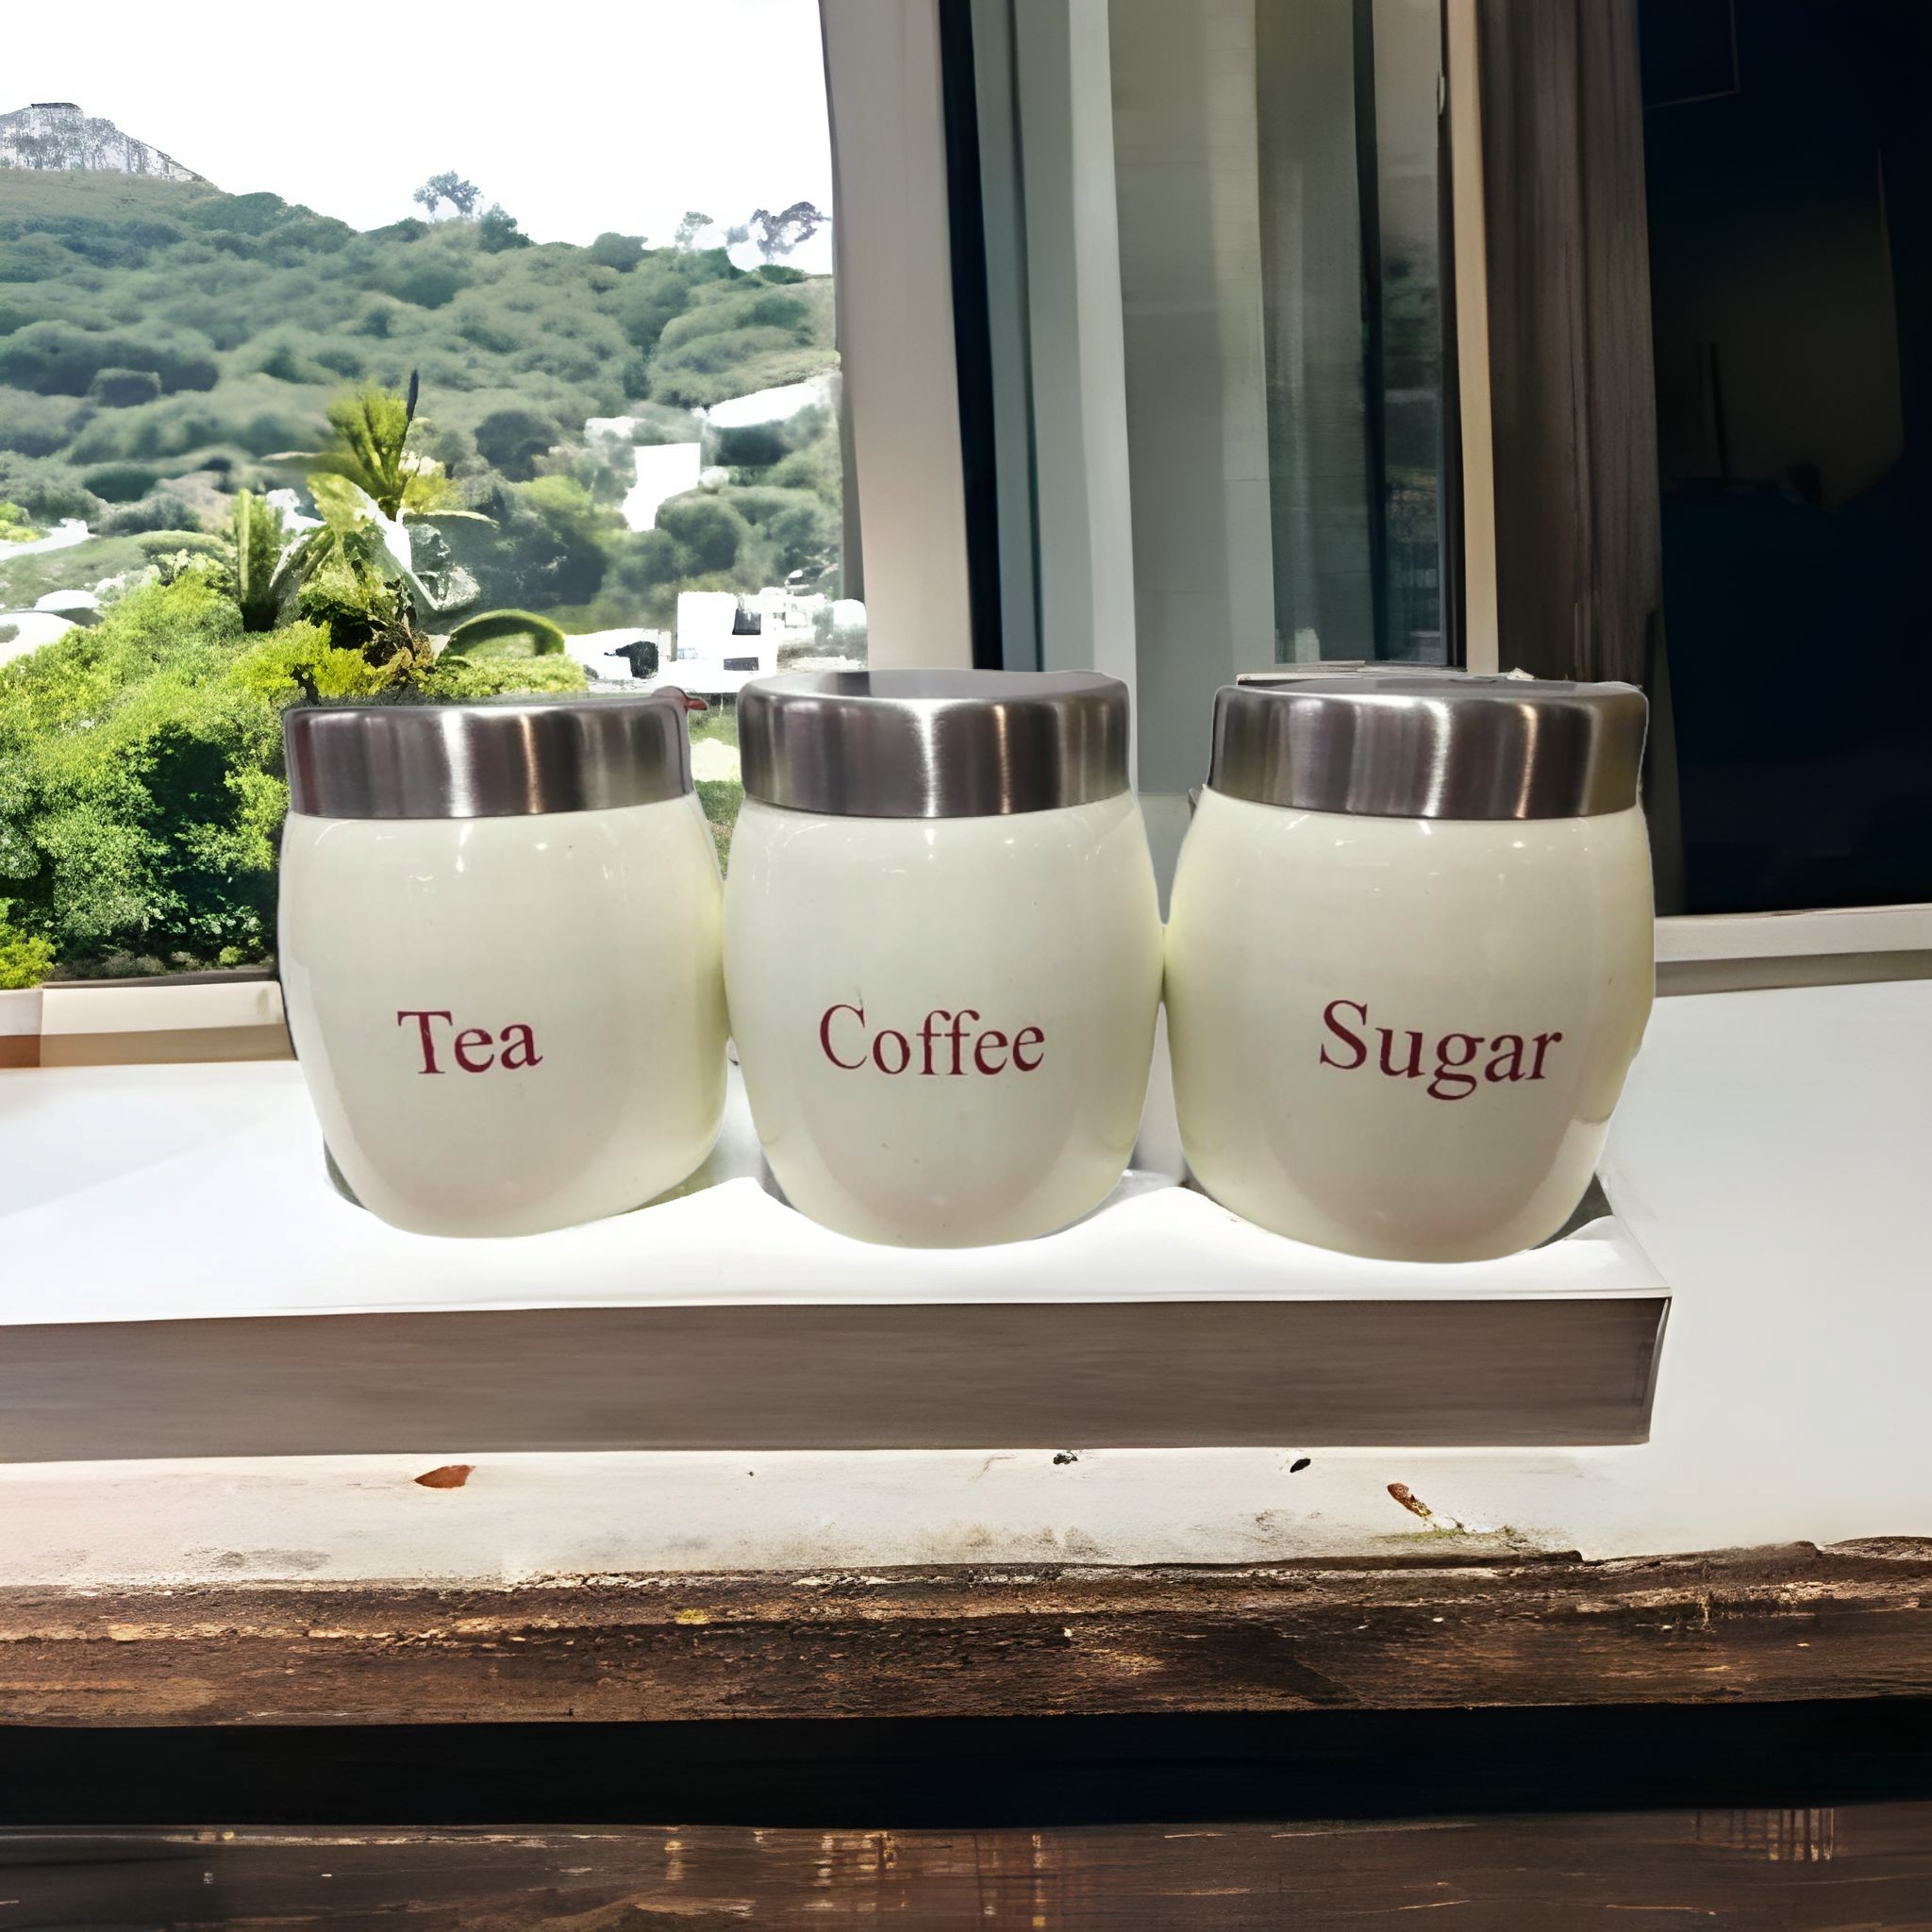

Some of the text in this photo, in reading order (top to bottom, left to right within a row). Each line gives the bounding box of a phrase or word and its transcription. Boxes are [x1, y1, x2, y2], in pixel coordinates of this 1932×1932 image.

[397, 1010, 543, 1075] Tea
[819, 1004, 1045, 1076] Coffee
[1320, 999, 1562, 1101] Sugar
